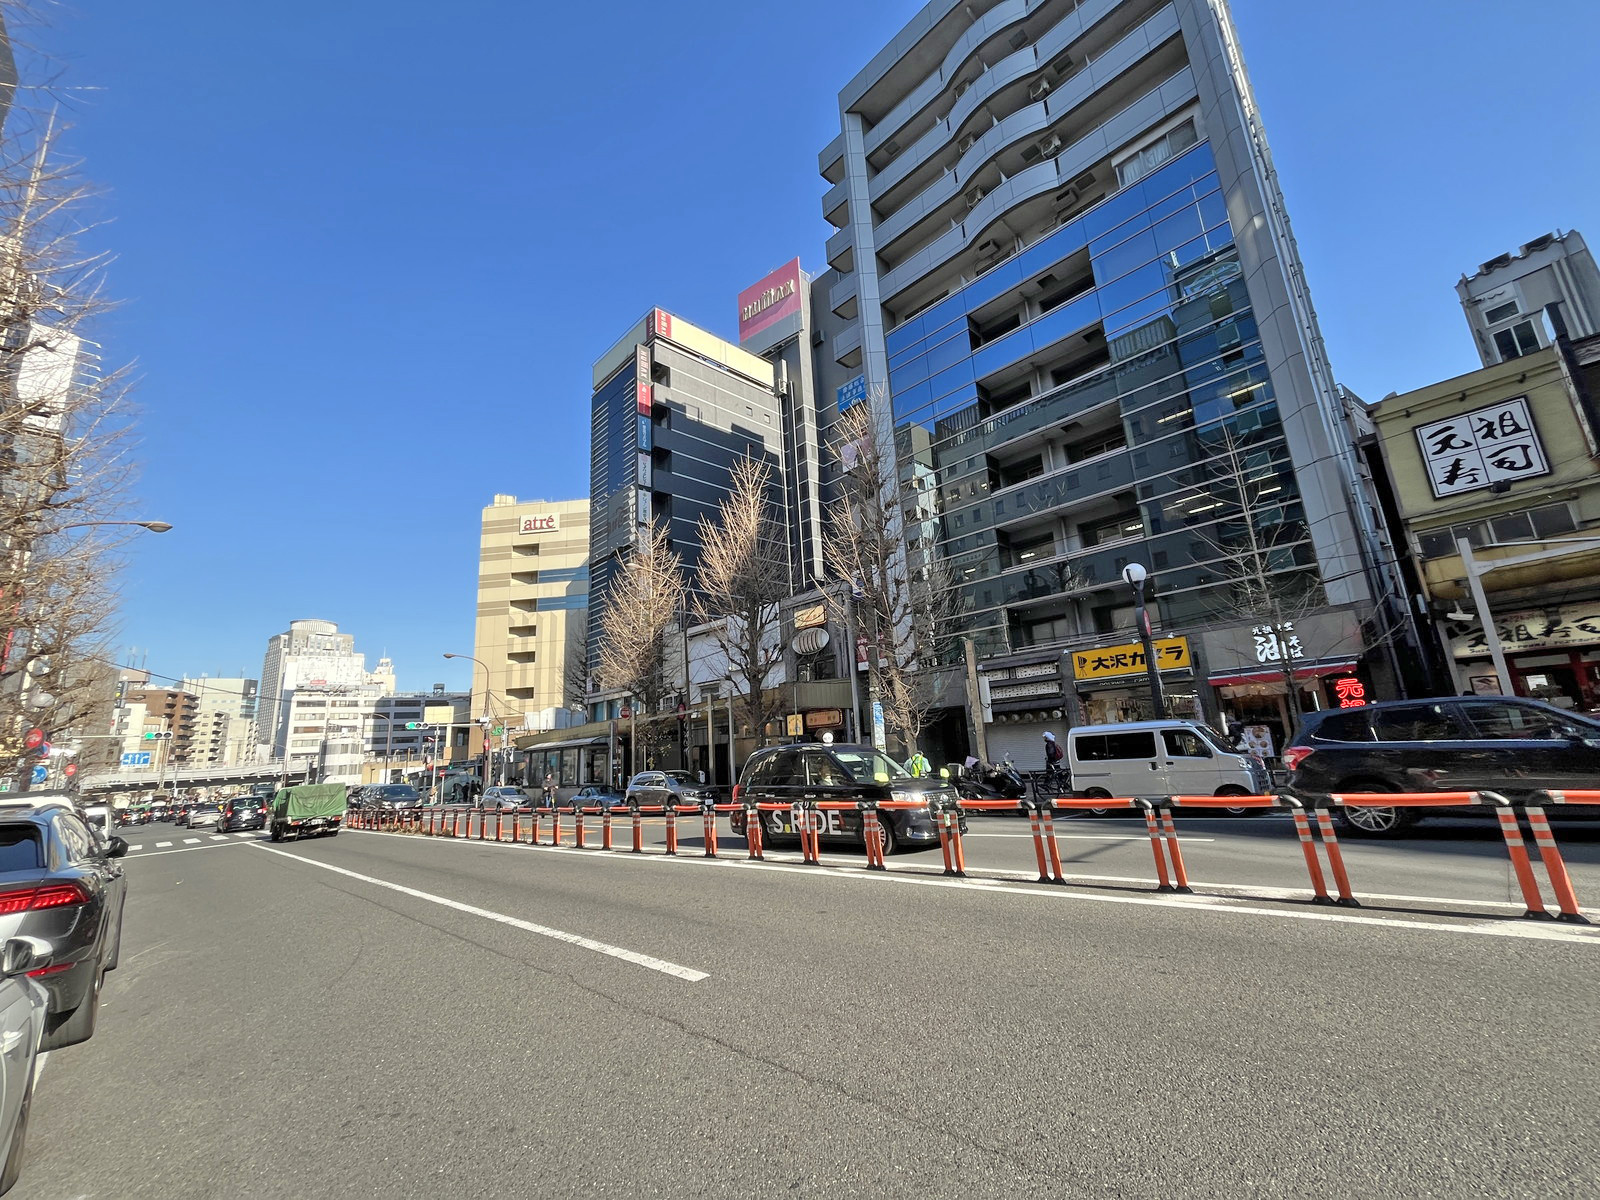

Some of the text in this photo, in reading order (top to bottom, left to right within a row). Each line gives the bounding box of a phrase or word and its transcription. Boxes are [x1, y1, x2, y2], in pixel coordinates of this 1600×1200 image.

[1426, 410, 1530, 456] 元祖
[1438, 444, 1535, 486] 寿司
[523, 515, 555, 531] atré
[772, 810, 842, 835] S.RIDE
